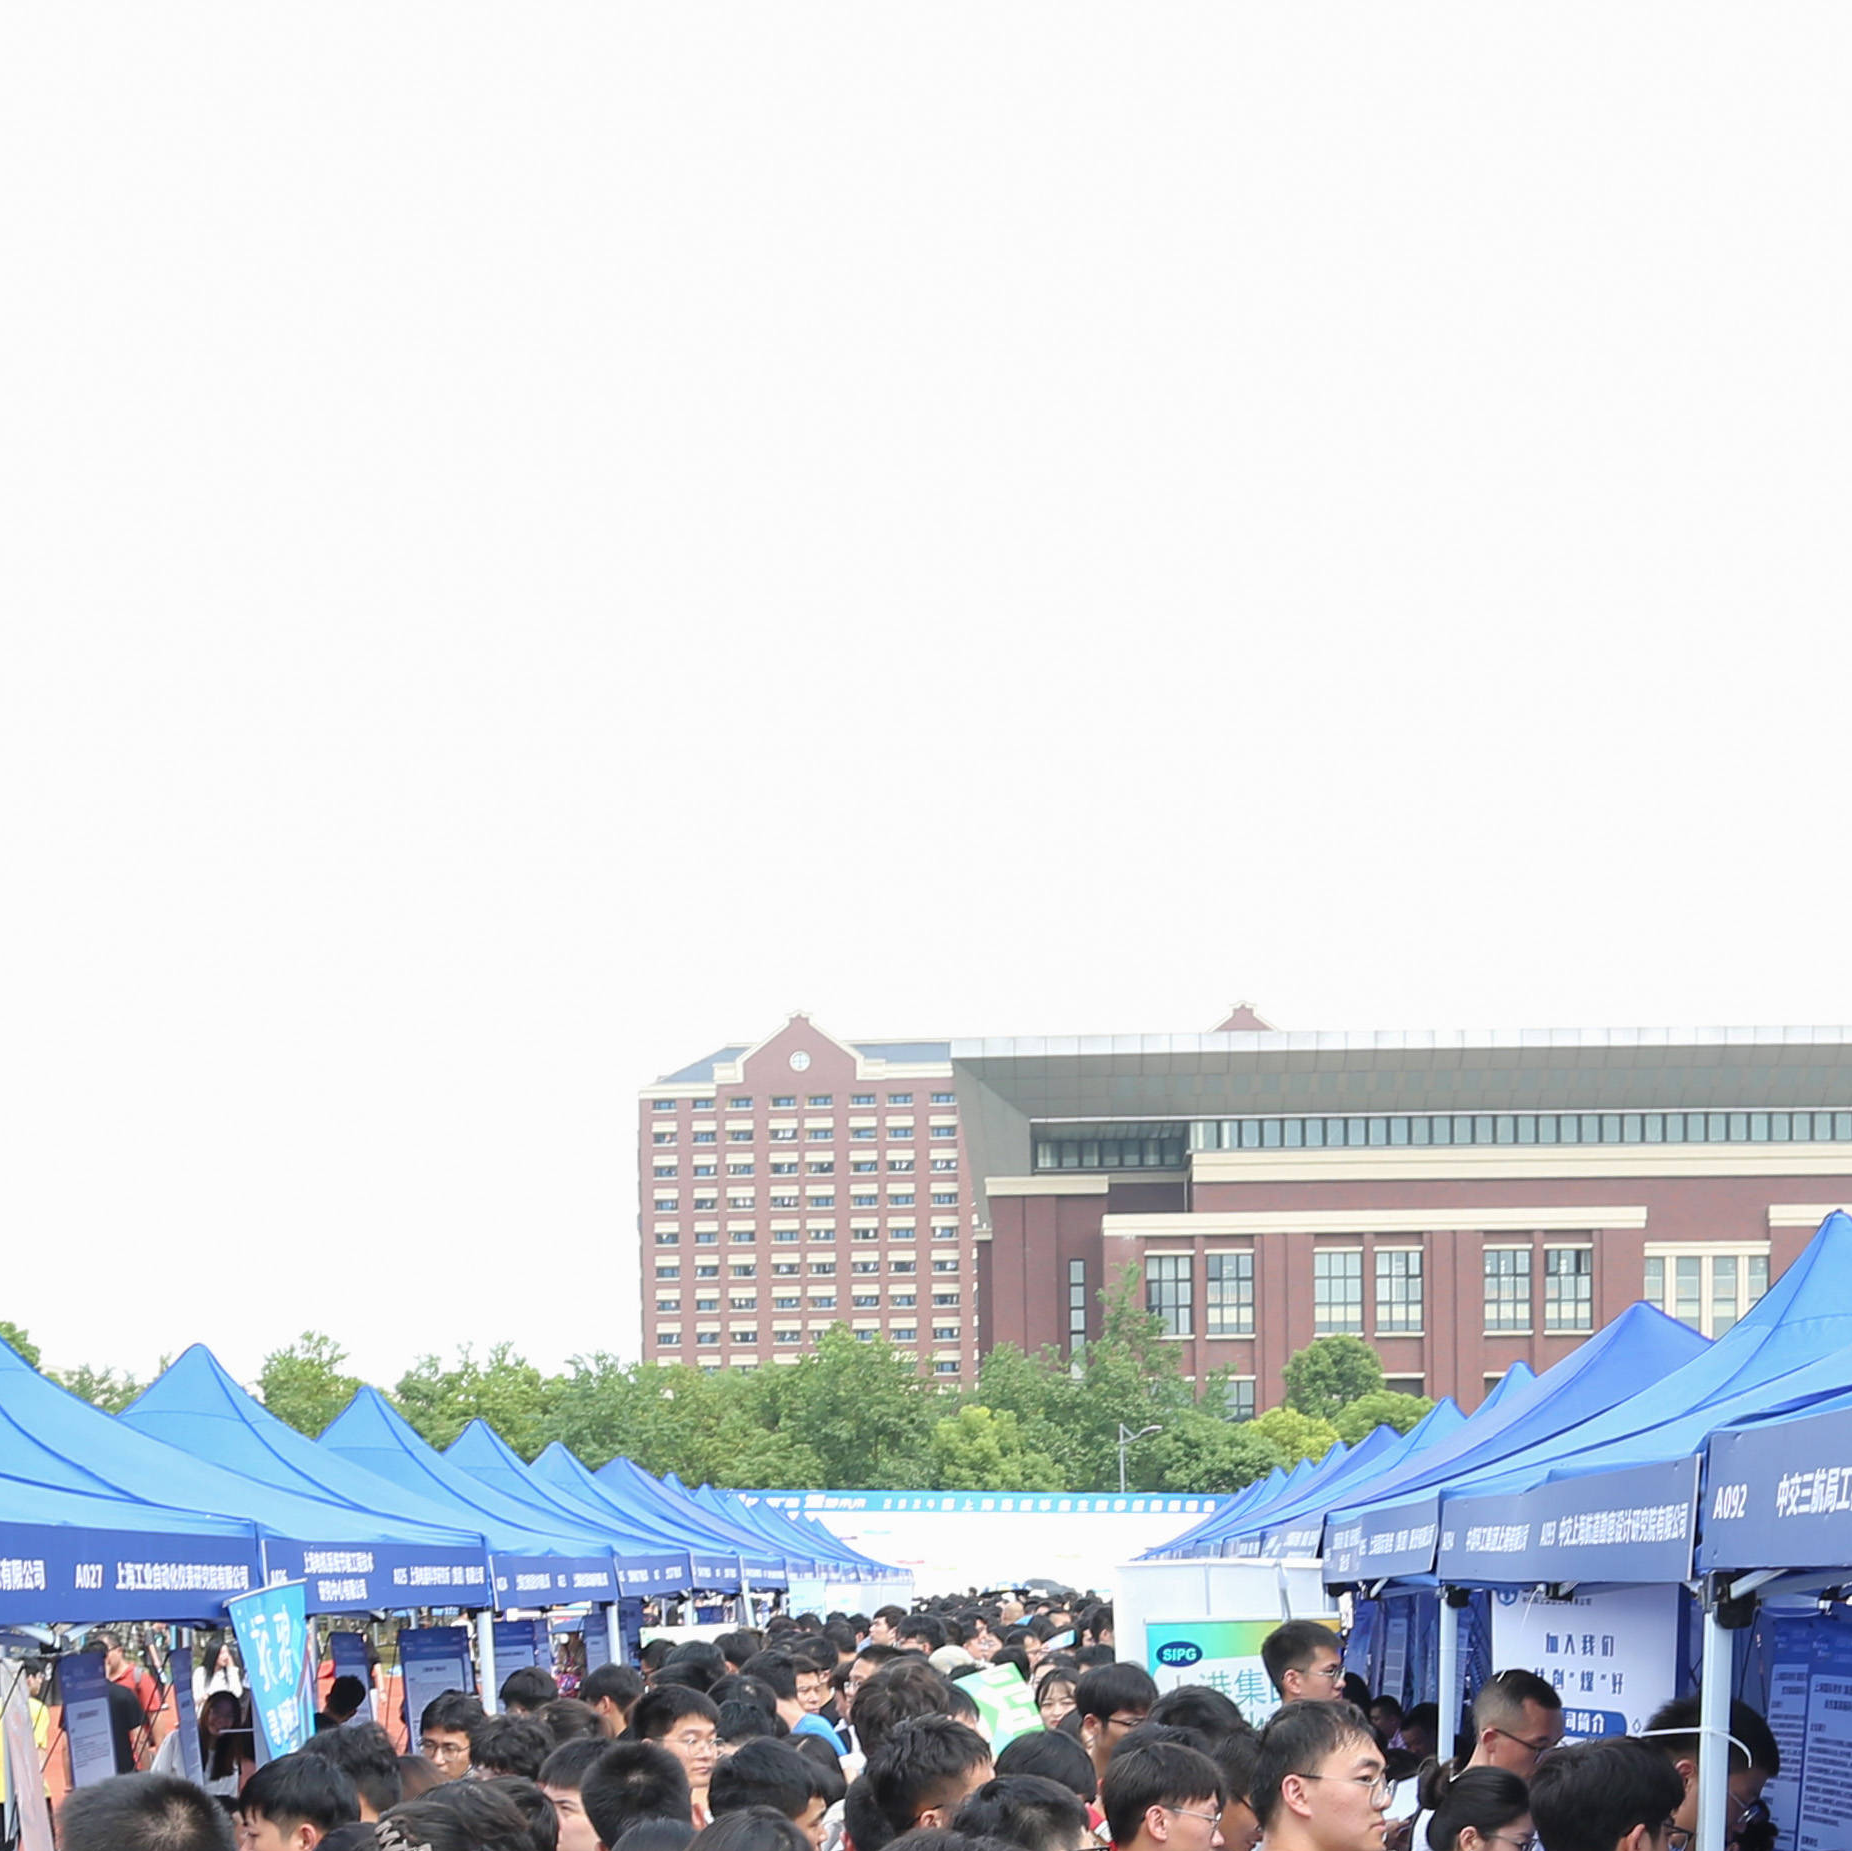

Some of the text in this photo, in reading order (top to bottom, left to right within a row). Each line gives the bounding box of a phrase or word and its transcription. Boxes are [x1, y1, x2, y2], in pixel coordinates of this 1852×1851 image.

[1712, 1484, 1747, 1520] A092
[75, 1562, 249, 1592] A027 上海工业自动化仪表研究院有限公司
[1162, 1648, 1197, 1662] SIPG
[1545, 1632, 1615, 1657] 加入我们
[1176, 1668, 1283, 1706] 港集
[1565, 1711, 1605, 1735] 司简介
